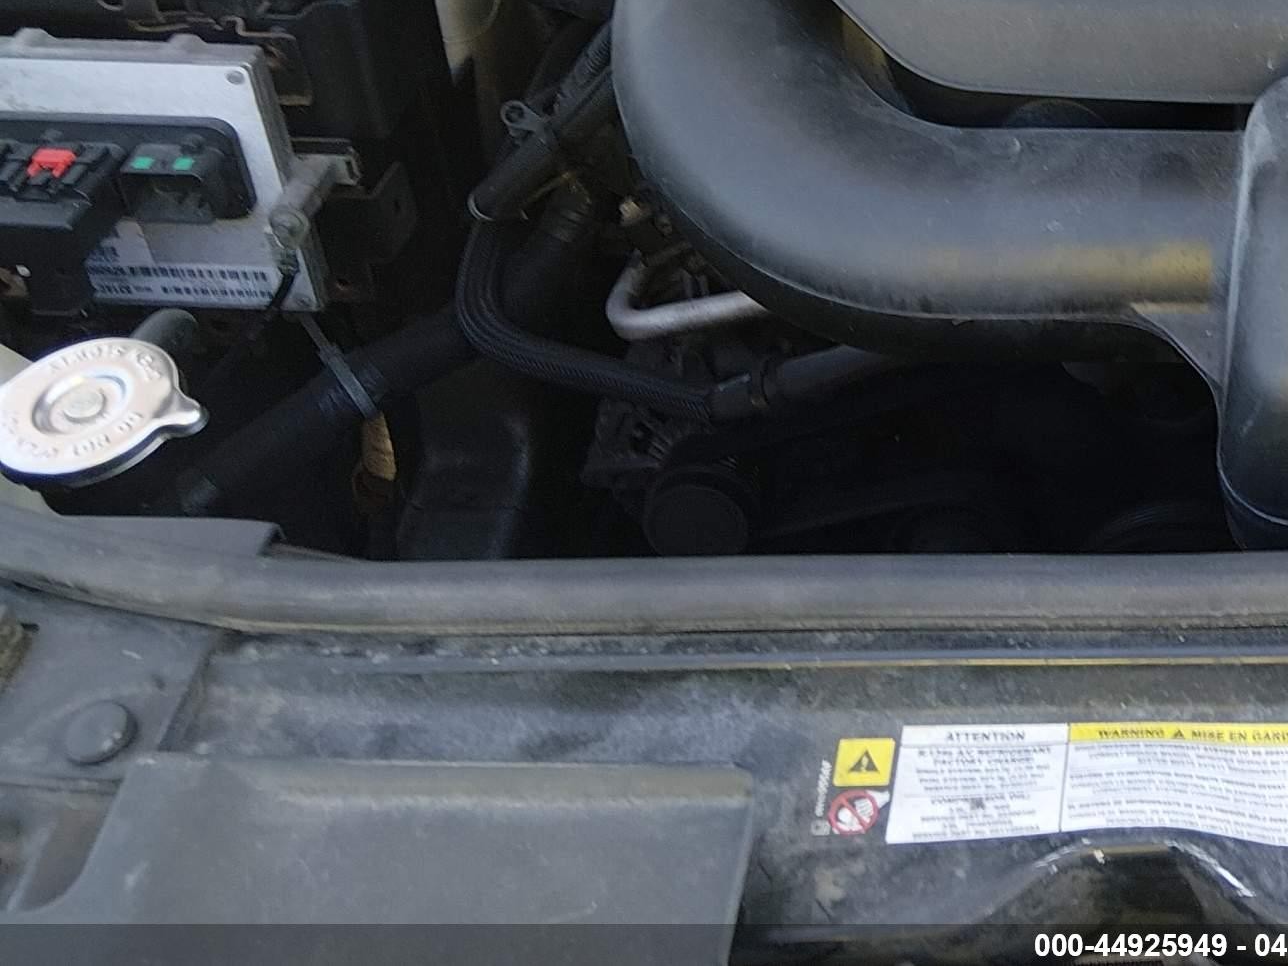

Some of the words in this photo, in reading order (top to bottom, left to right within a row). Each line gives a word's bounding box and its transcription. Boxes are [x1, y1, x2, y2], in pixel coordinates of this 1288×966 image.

[946, 730, 1025, 741] ATTENTION
[1098, 729, 1164, 739] WARNING
[1191, 731, 1224, 741] MISE
[1229, 731, 1248, 741] EN
